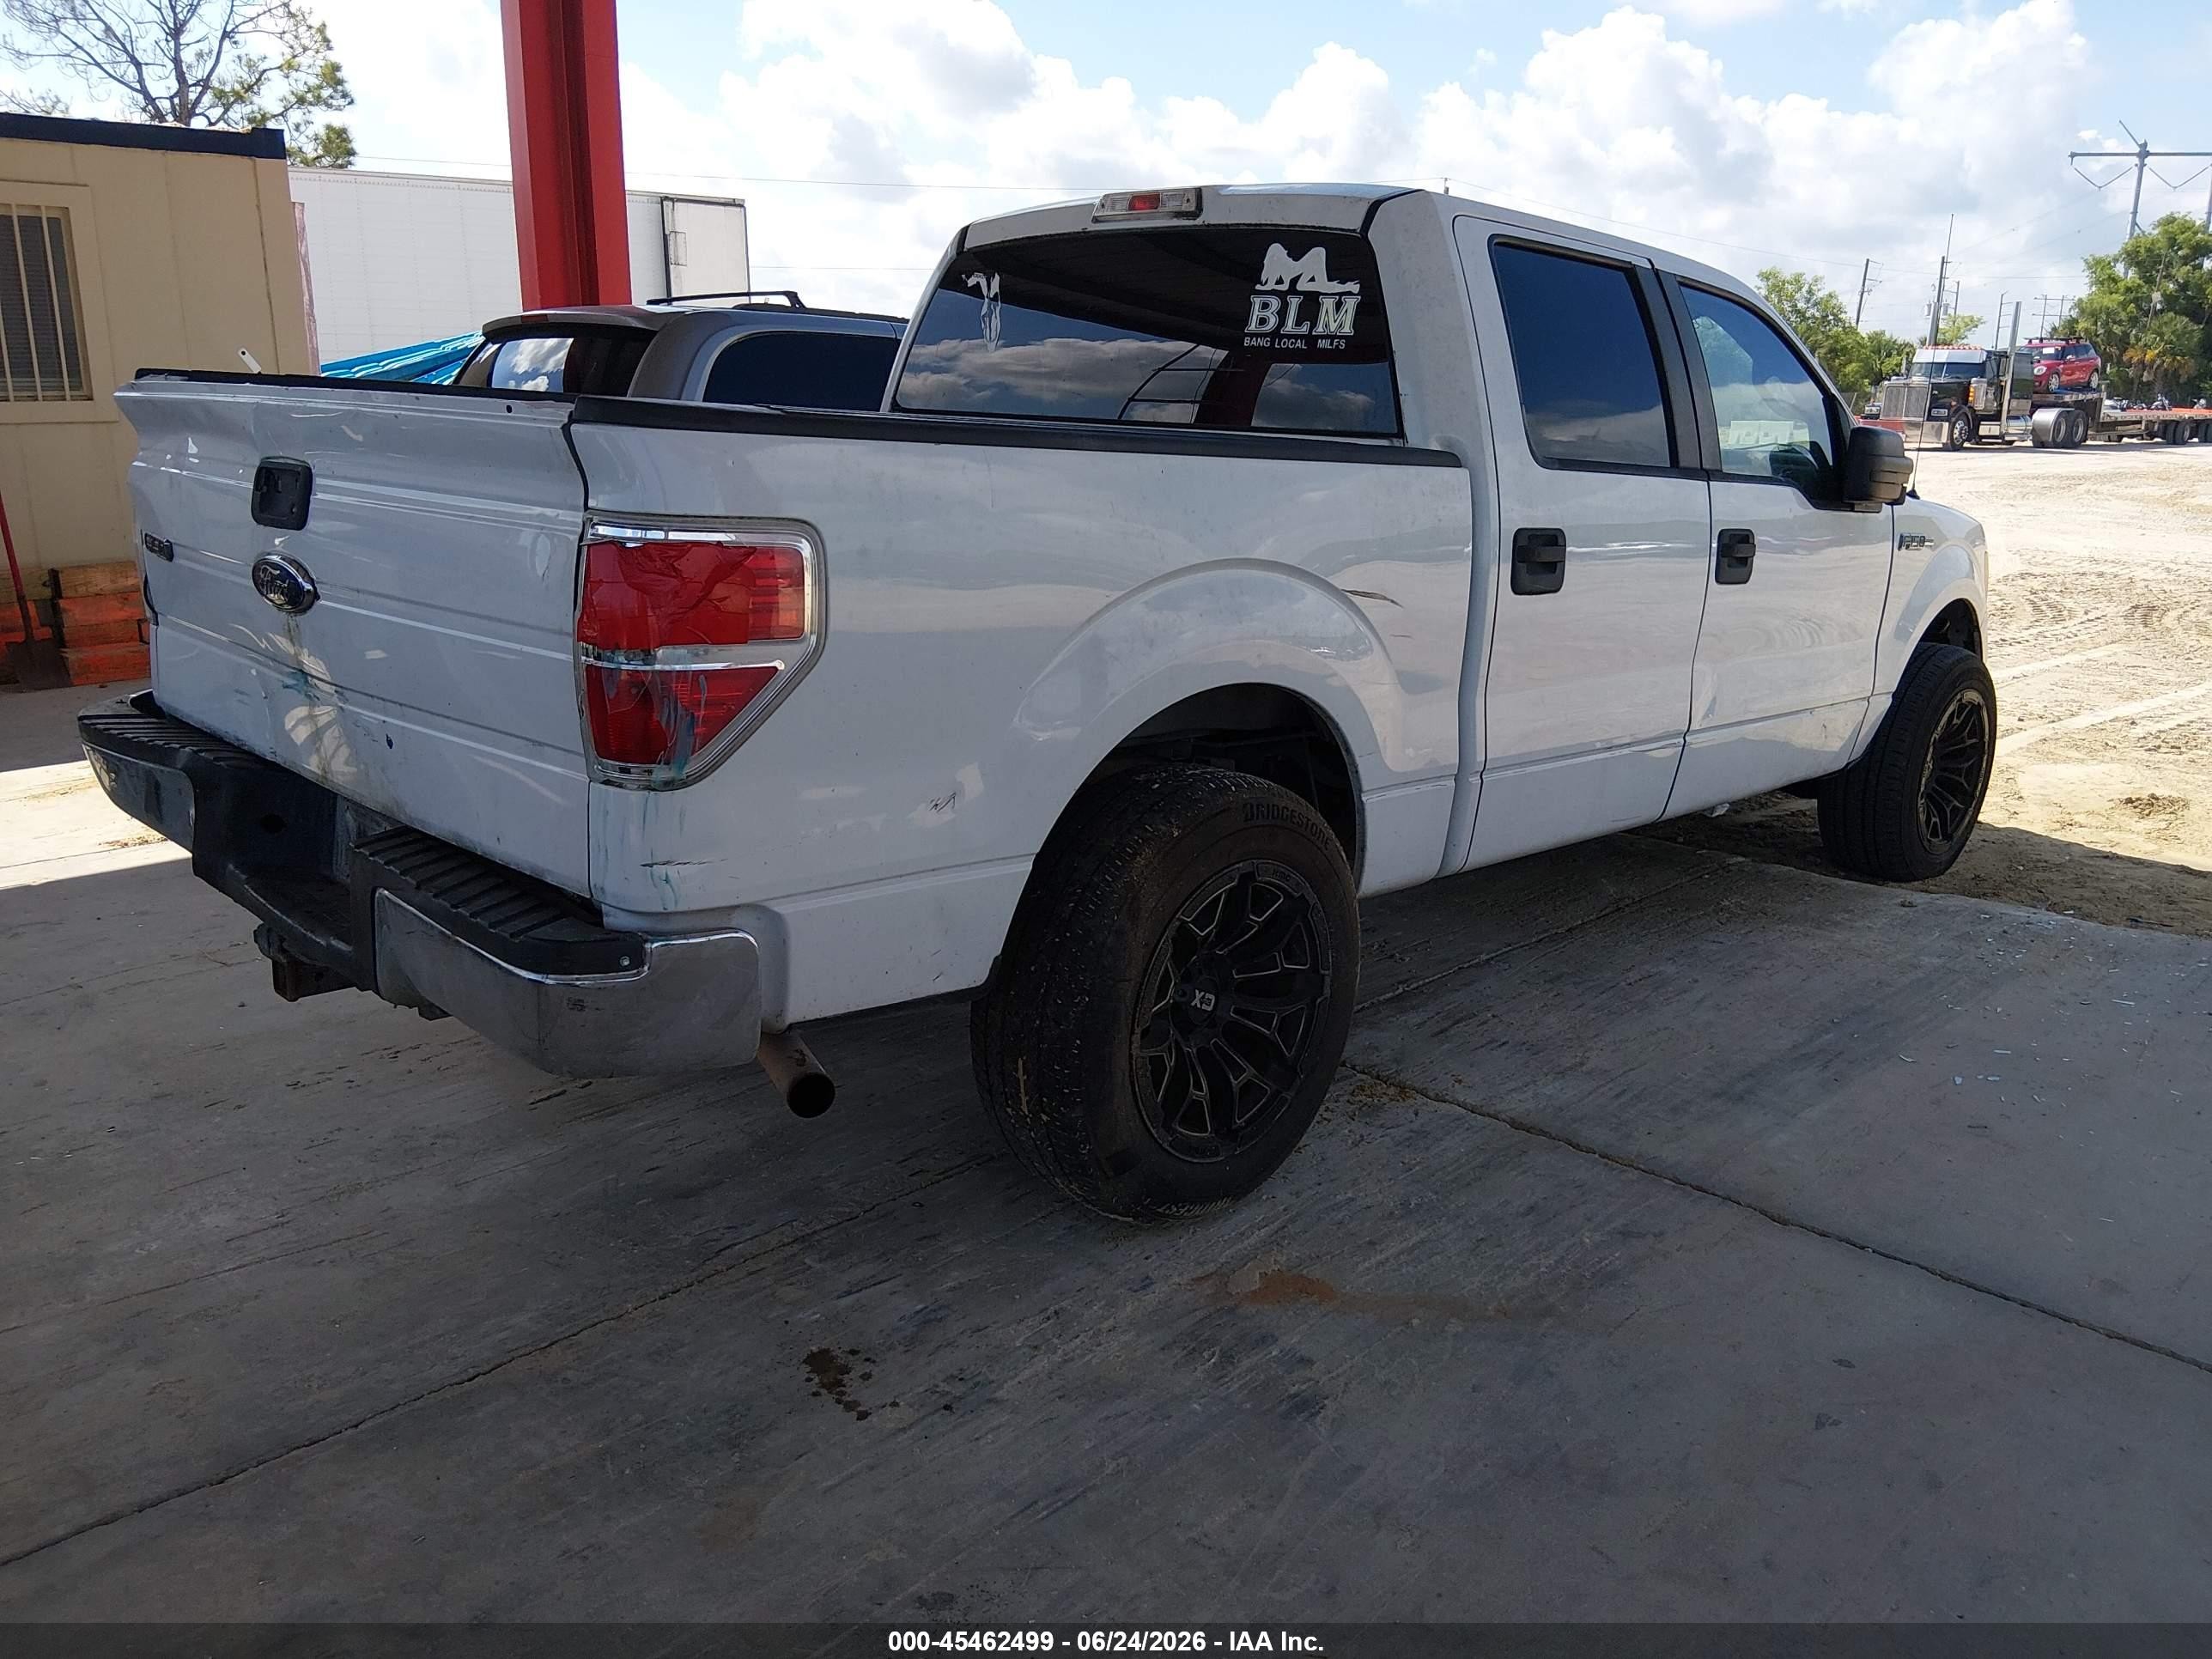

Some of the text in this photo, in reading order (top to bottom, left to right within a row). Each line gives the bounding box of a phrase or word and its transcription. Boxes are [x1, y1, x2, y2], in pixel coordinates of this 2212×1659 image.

[1245, 295, 1361, 335] BLM
[1243, 337, 1346, 349] BANG LOCAL MILFS
[1243, 802, 1333, 851] BRIDGESTONE
